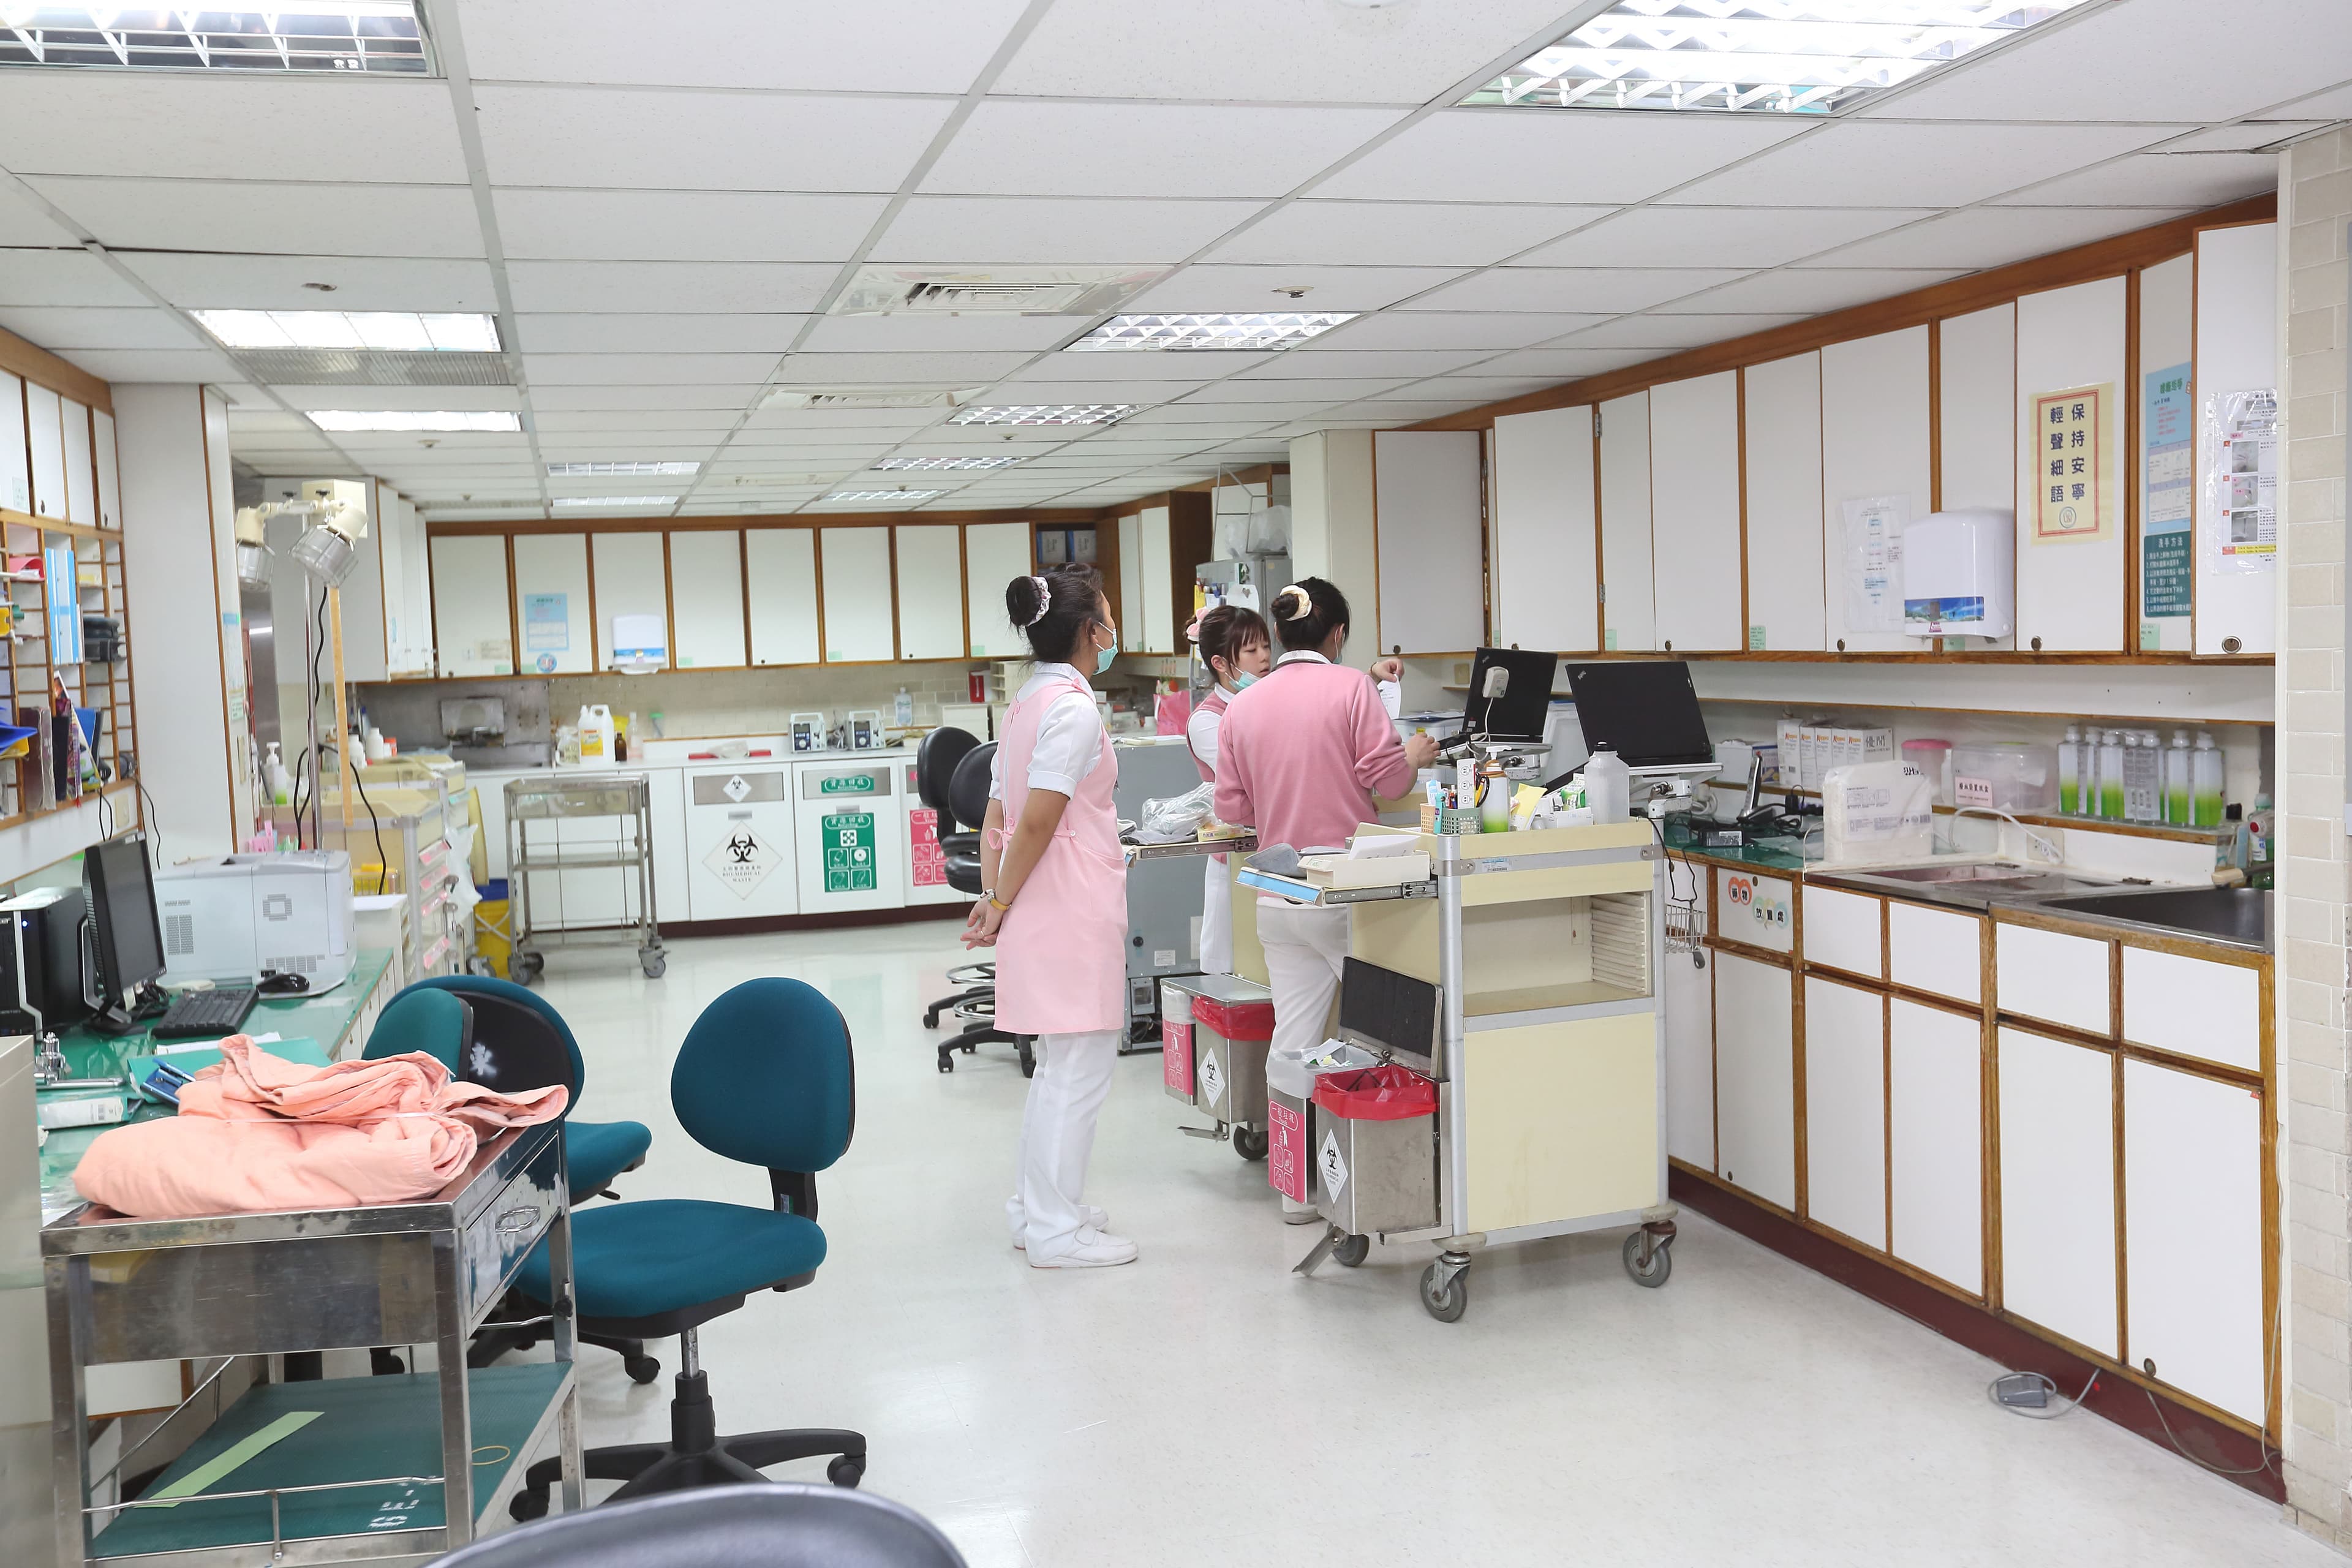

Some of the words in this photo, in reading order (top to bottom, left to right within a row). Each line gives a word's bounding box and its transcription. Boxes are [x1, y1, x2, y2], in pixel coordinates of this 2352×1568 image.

[2050, 406, 2064, 503] 輕聲細語
[2071, 403, 2085, 500] 保持安寧
